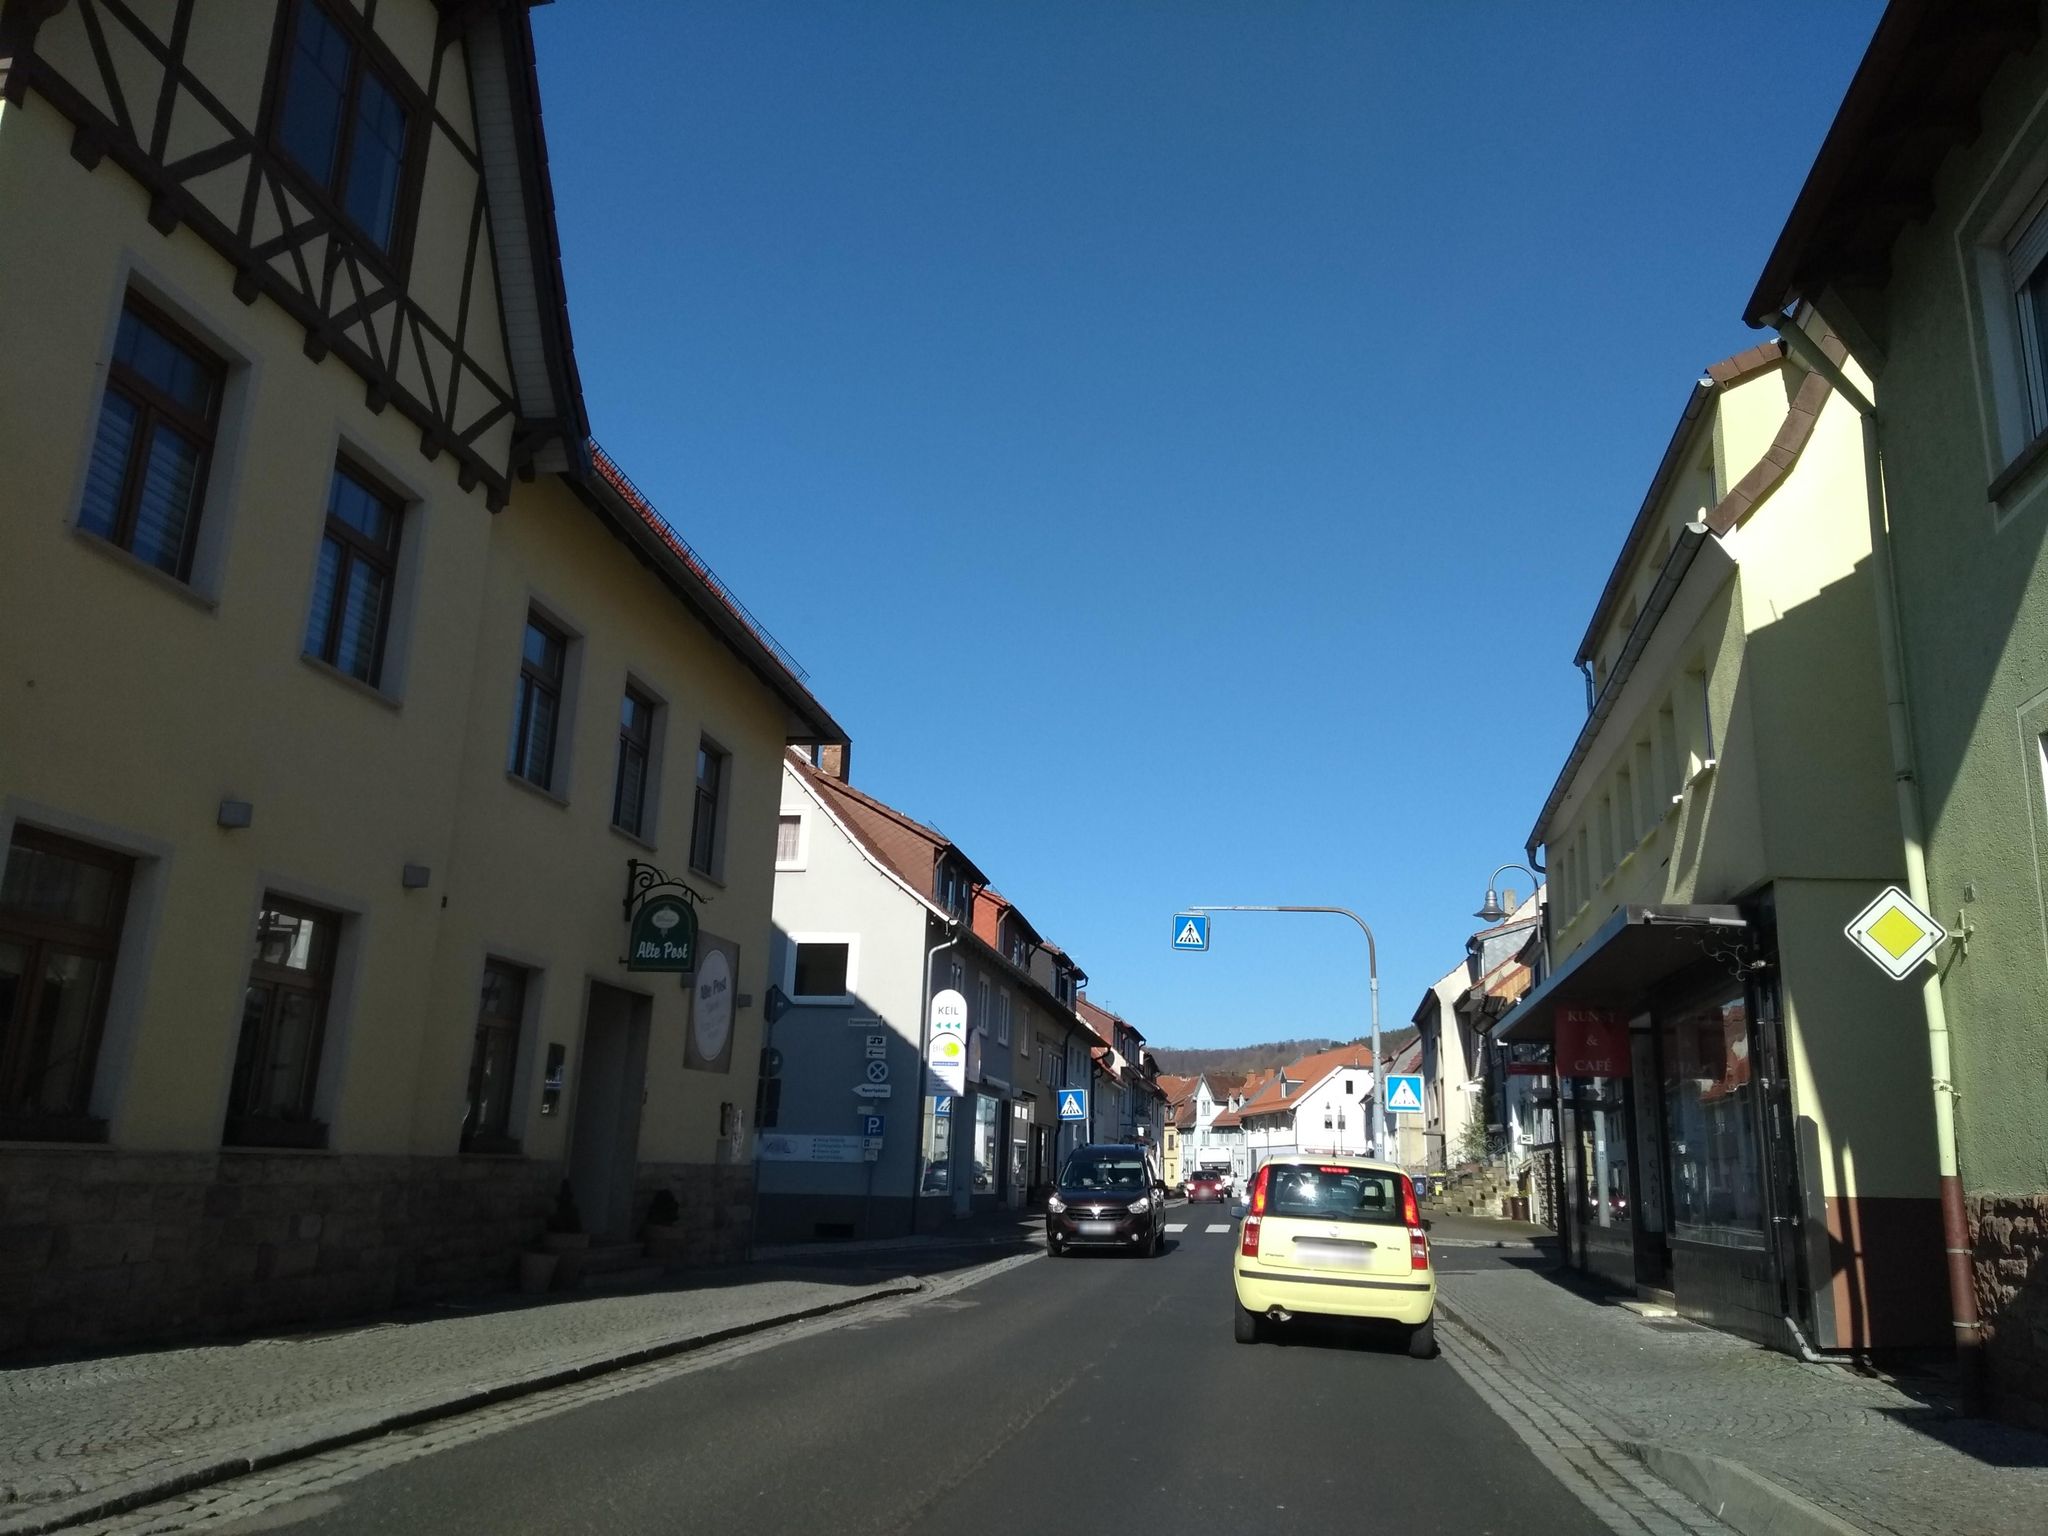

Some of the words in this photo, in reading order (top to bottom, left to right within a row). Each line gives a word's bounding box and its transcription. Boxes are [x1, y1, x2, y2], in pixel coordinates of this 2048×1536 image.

[636, 941, 661, 958] Alte
[664, 941, 688, 959] Post
[712, 976, 727, 995] Post
[938, 1006, 959, 1015] KEIL
[1585, 1034, 1600, 1047] &
[1574, 1058, 1612, 1071] CAFÉ
[867, 1117, 880, 1134] P
